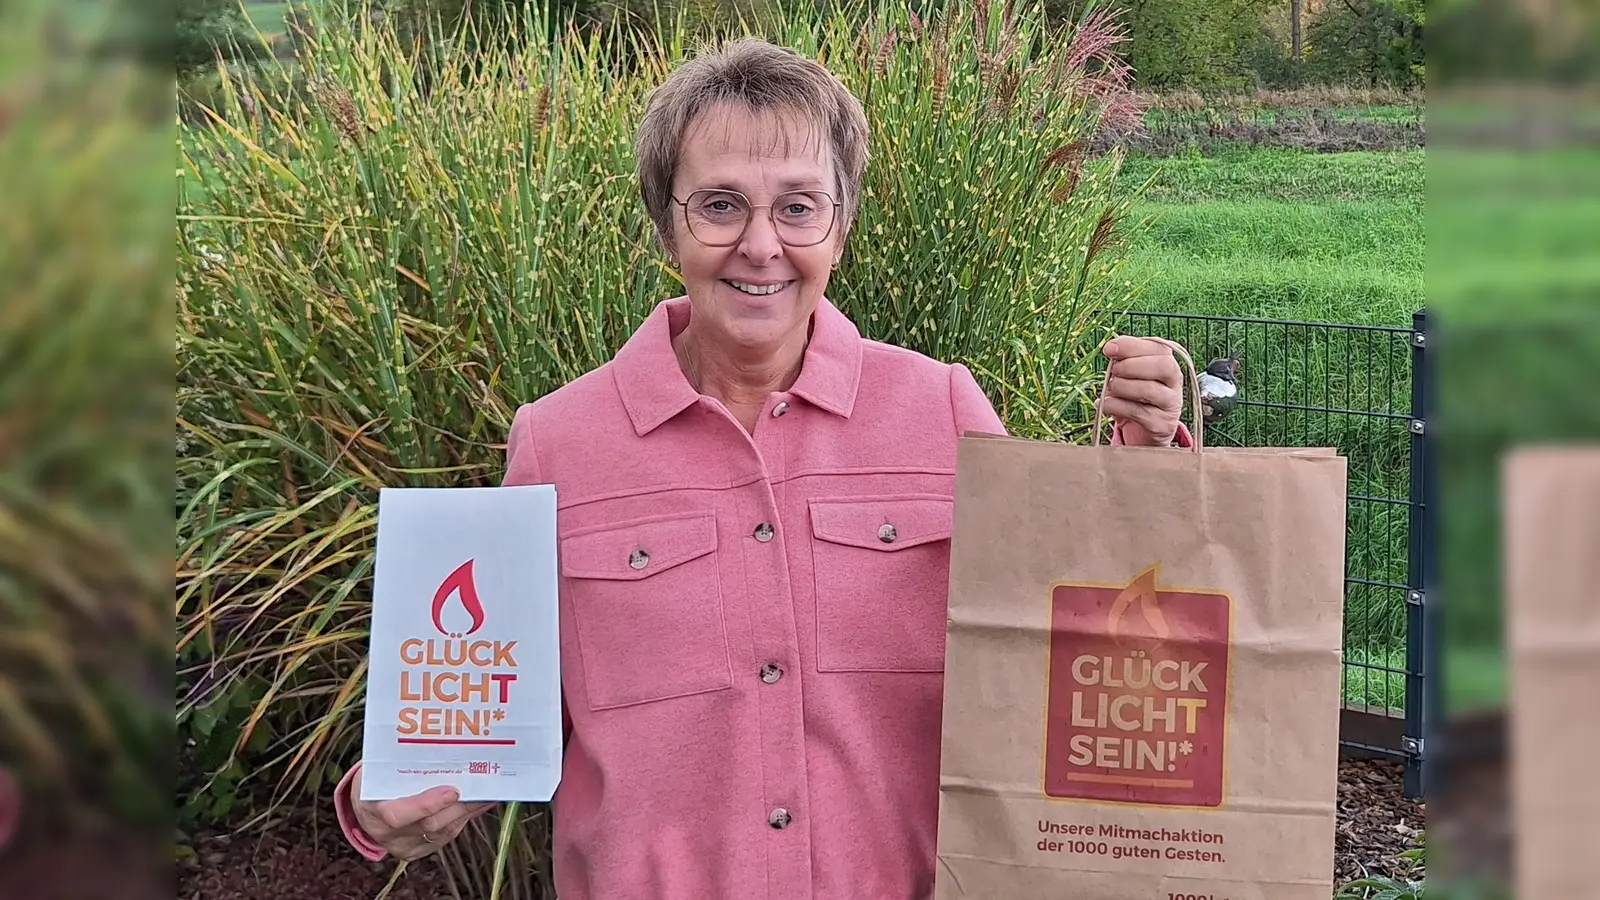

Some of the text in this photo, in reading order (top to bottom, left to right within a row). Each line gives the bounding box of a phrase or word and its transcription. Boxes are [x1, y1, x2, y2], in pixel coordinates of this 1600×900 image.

[400, 632, 518, 667] GLÜCK
[400, 671, 517, 703] LICHT
[1071, 650, 1209, 692] GLÜCK
[1071, 691, 1207, 734] LICHT
[1037, 820, 1224, 844] Unsere Mitmachaktion
[1036, 838, 1226, 863] der 1000 guten Gesten.
